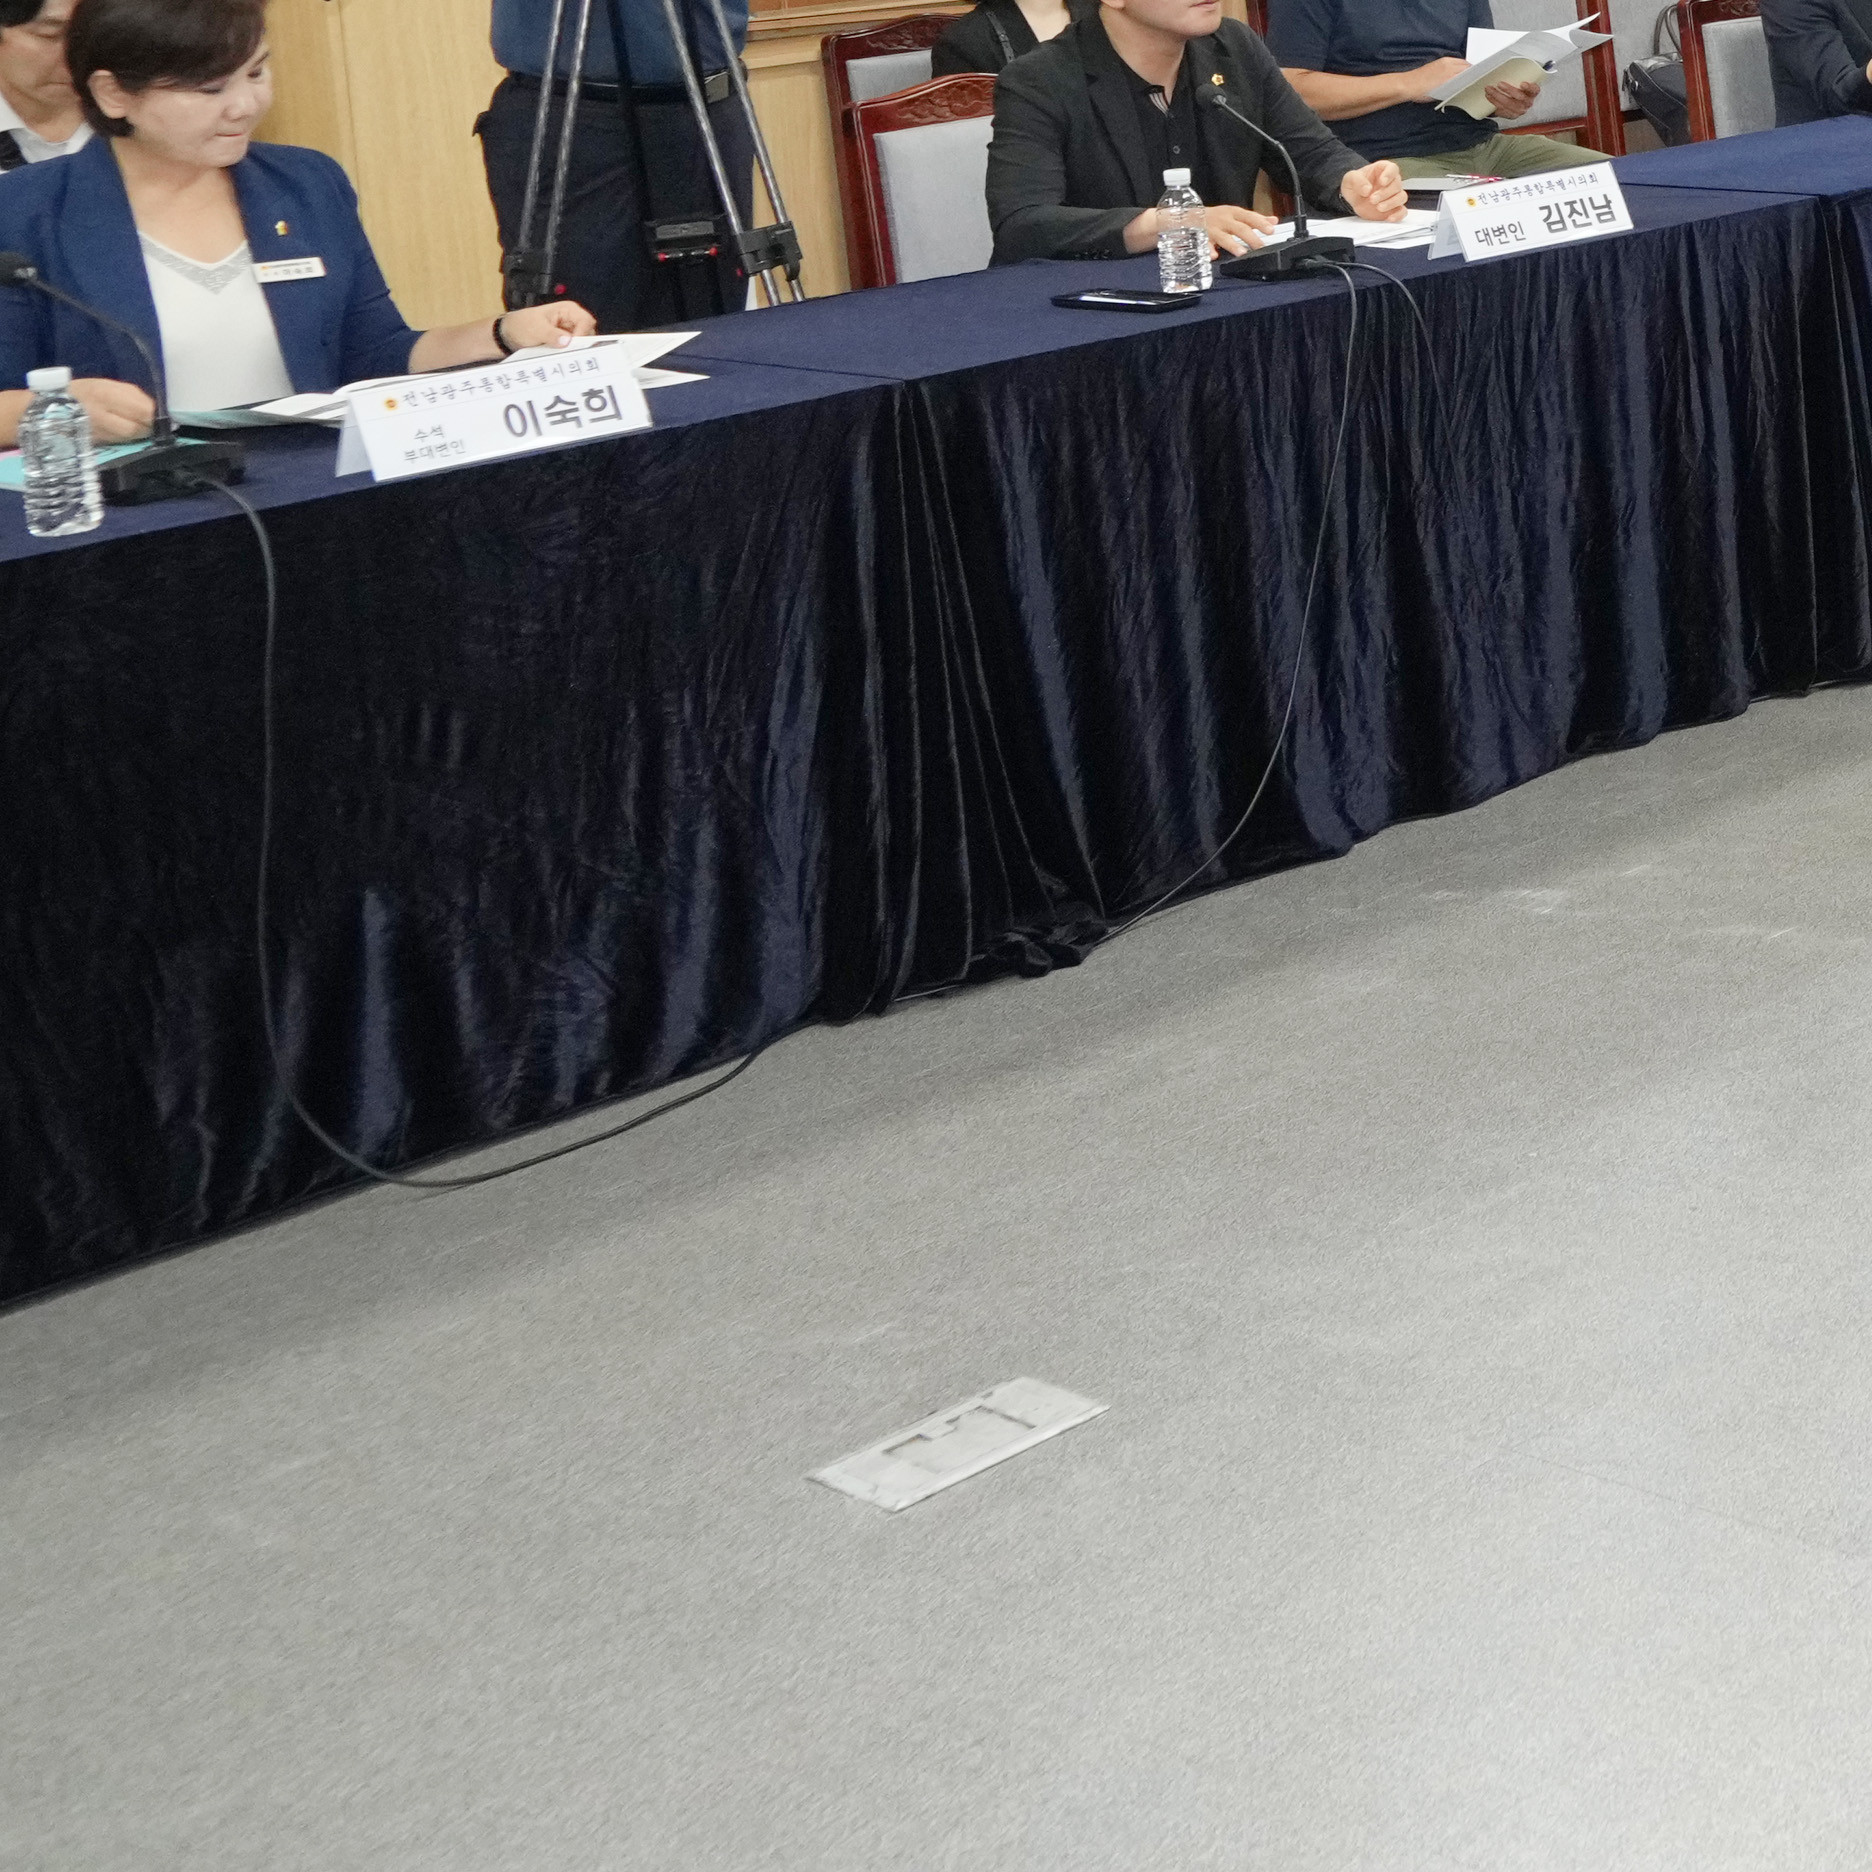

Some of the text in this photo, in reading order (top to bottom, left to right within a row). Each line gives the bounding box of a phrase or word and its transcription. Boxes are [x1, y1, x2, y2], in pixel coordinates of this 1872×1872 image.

[1478, 172, 1600, 206] 전남광주통합특별시의회
[1475, 193, 1617, 247] 대변인 김진남
[403, 357, 601, 407] 전남광주통합특별시의회
[413, 424, 445, 442] 수석
[504, 385, 624, 440] 이숙희
[404, 439, 466, 465] 부대변인
